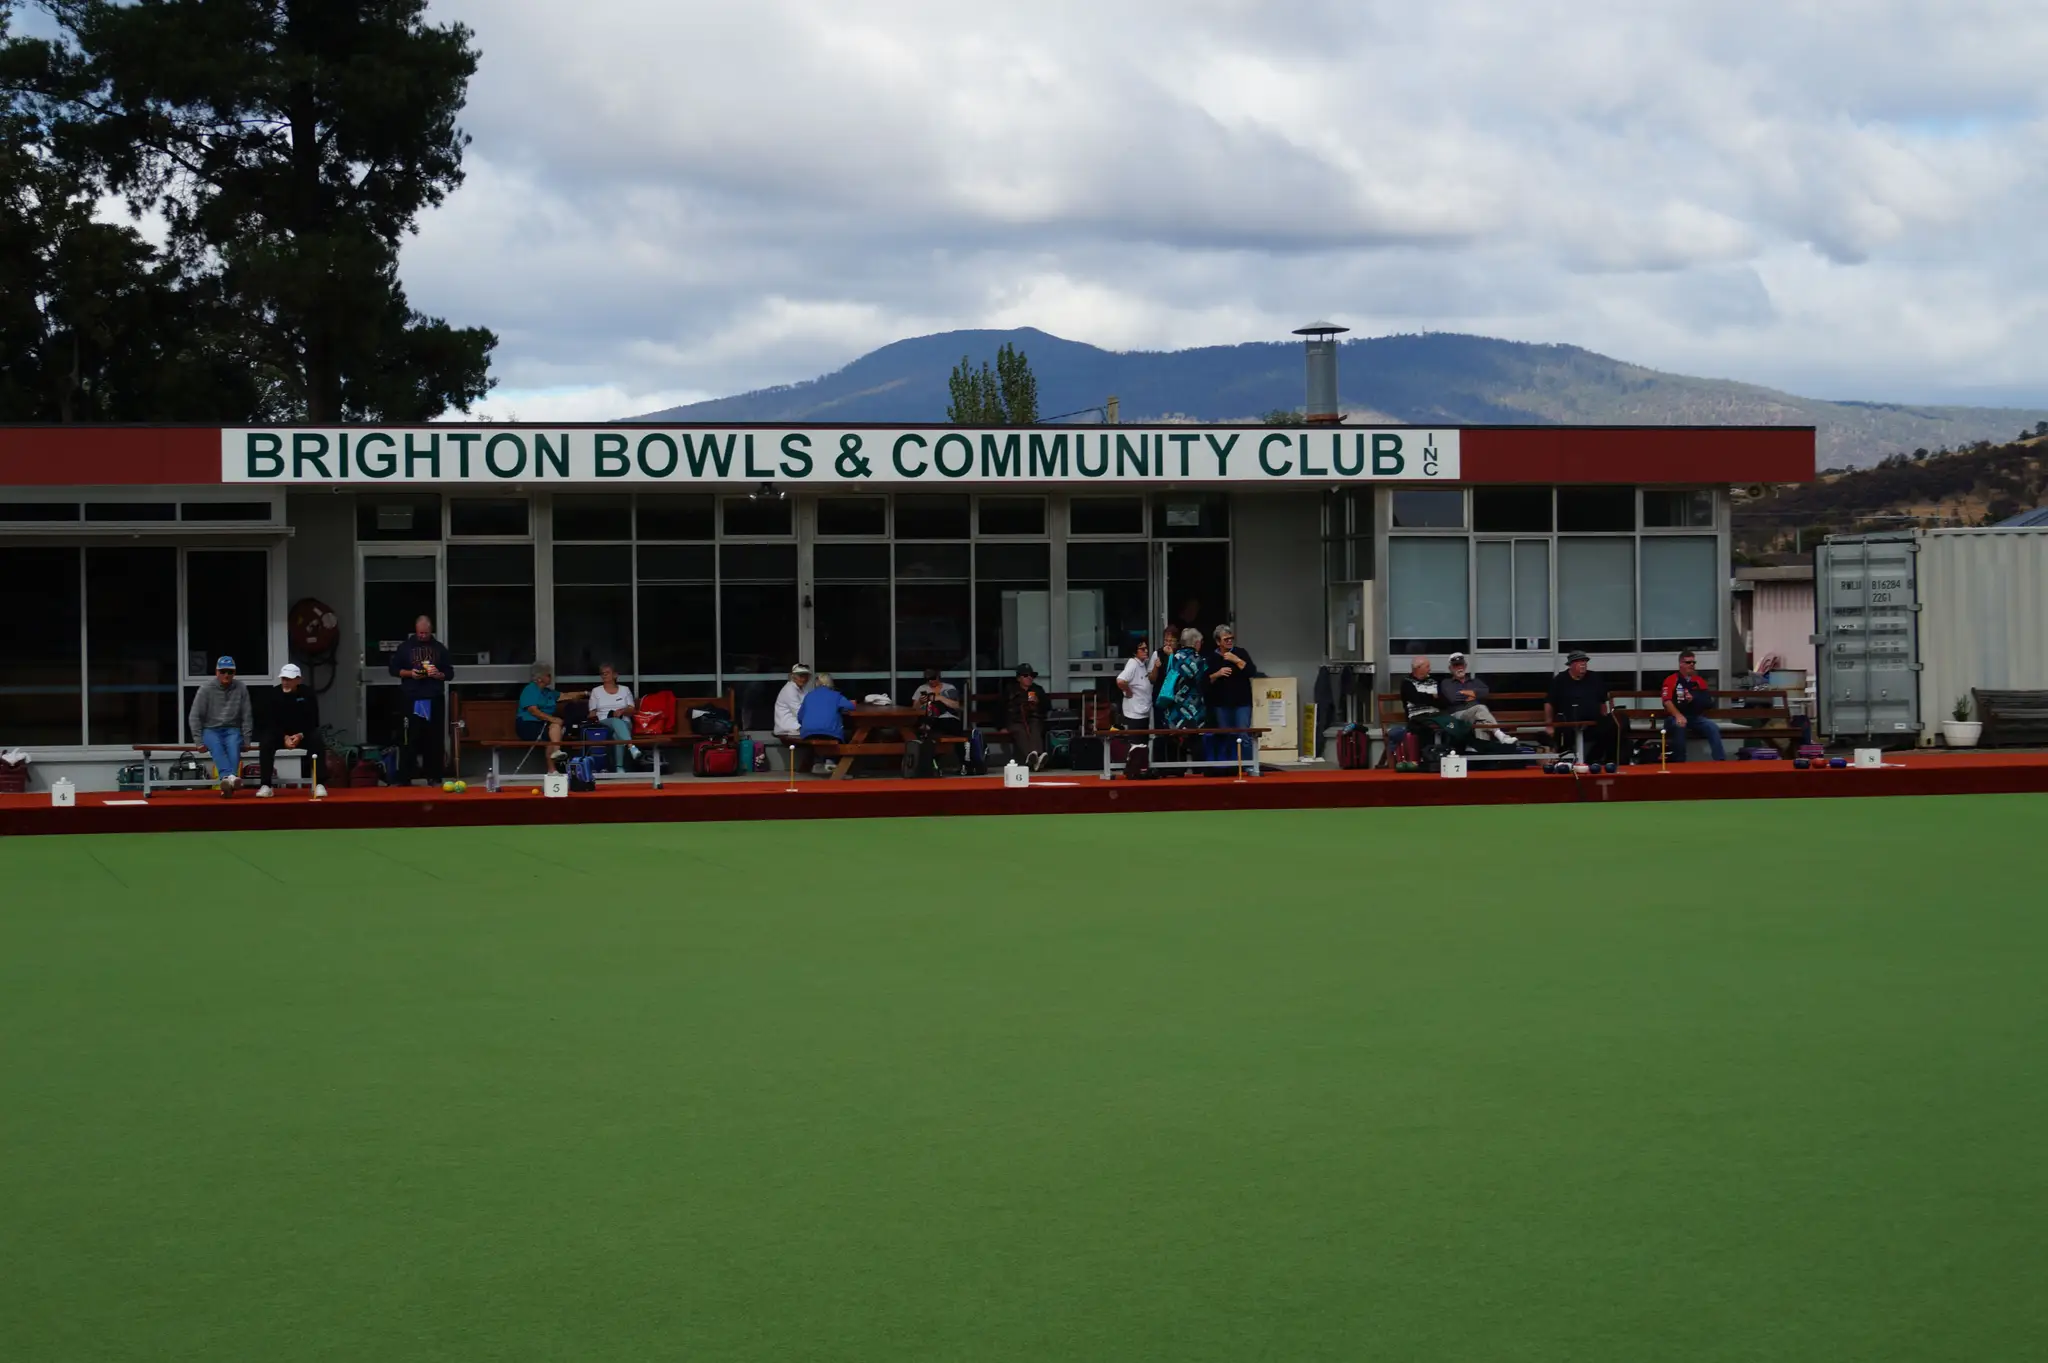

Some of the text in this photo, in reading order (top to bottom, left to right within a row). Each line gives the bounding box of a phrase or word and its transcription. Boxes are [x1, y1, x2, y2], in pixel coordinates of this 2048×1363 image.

[247, 433, 1404, 478] BRIGHTON BOWLS & COMMUNITY CLUB
[1423, 432, 1439, 477] INC
[1454, 765, 1461, 773] 7
[1015, 773, 1023, 782] 6
[553, 783, 561, 793] 5
[1595, 779, 1614, 801] T
[59, 793, 67, 801] 4
